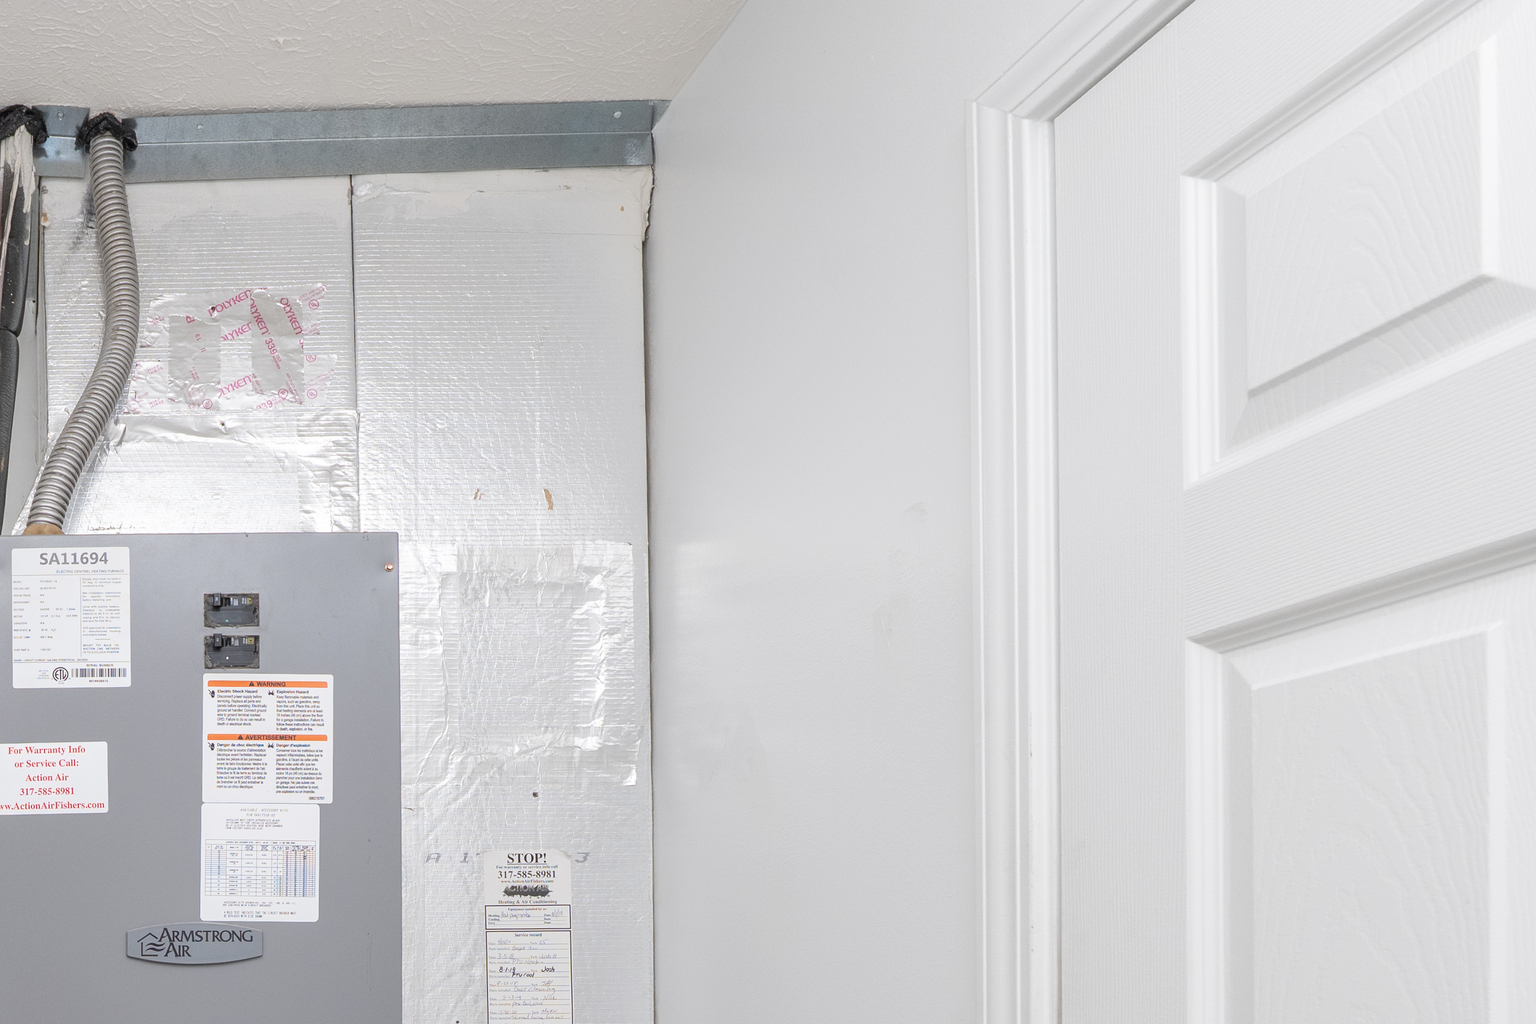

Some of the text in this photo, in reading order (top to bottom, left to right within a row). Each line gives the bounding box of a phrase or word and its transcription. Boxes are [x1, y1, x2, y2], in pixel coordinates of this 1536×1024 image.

[39, 552, 108, 565] SA11694
[25, 746, 66, 755] Warranty
[68, 745, 86, 753] Info
[26, 760, 57, 768] Service
[58, 759, 79, 767] Call:
[25, 774, 53, 782] Action
[19, 787, 75, 796] 317-585-8981
[507, 853, 547, 864] STOP!
[497, 870, 556, 879] 317-585-8981
[158, 928, 253, 942] ARMSTRONG
[164, 943, 191, 957] AIR
